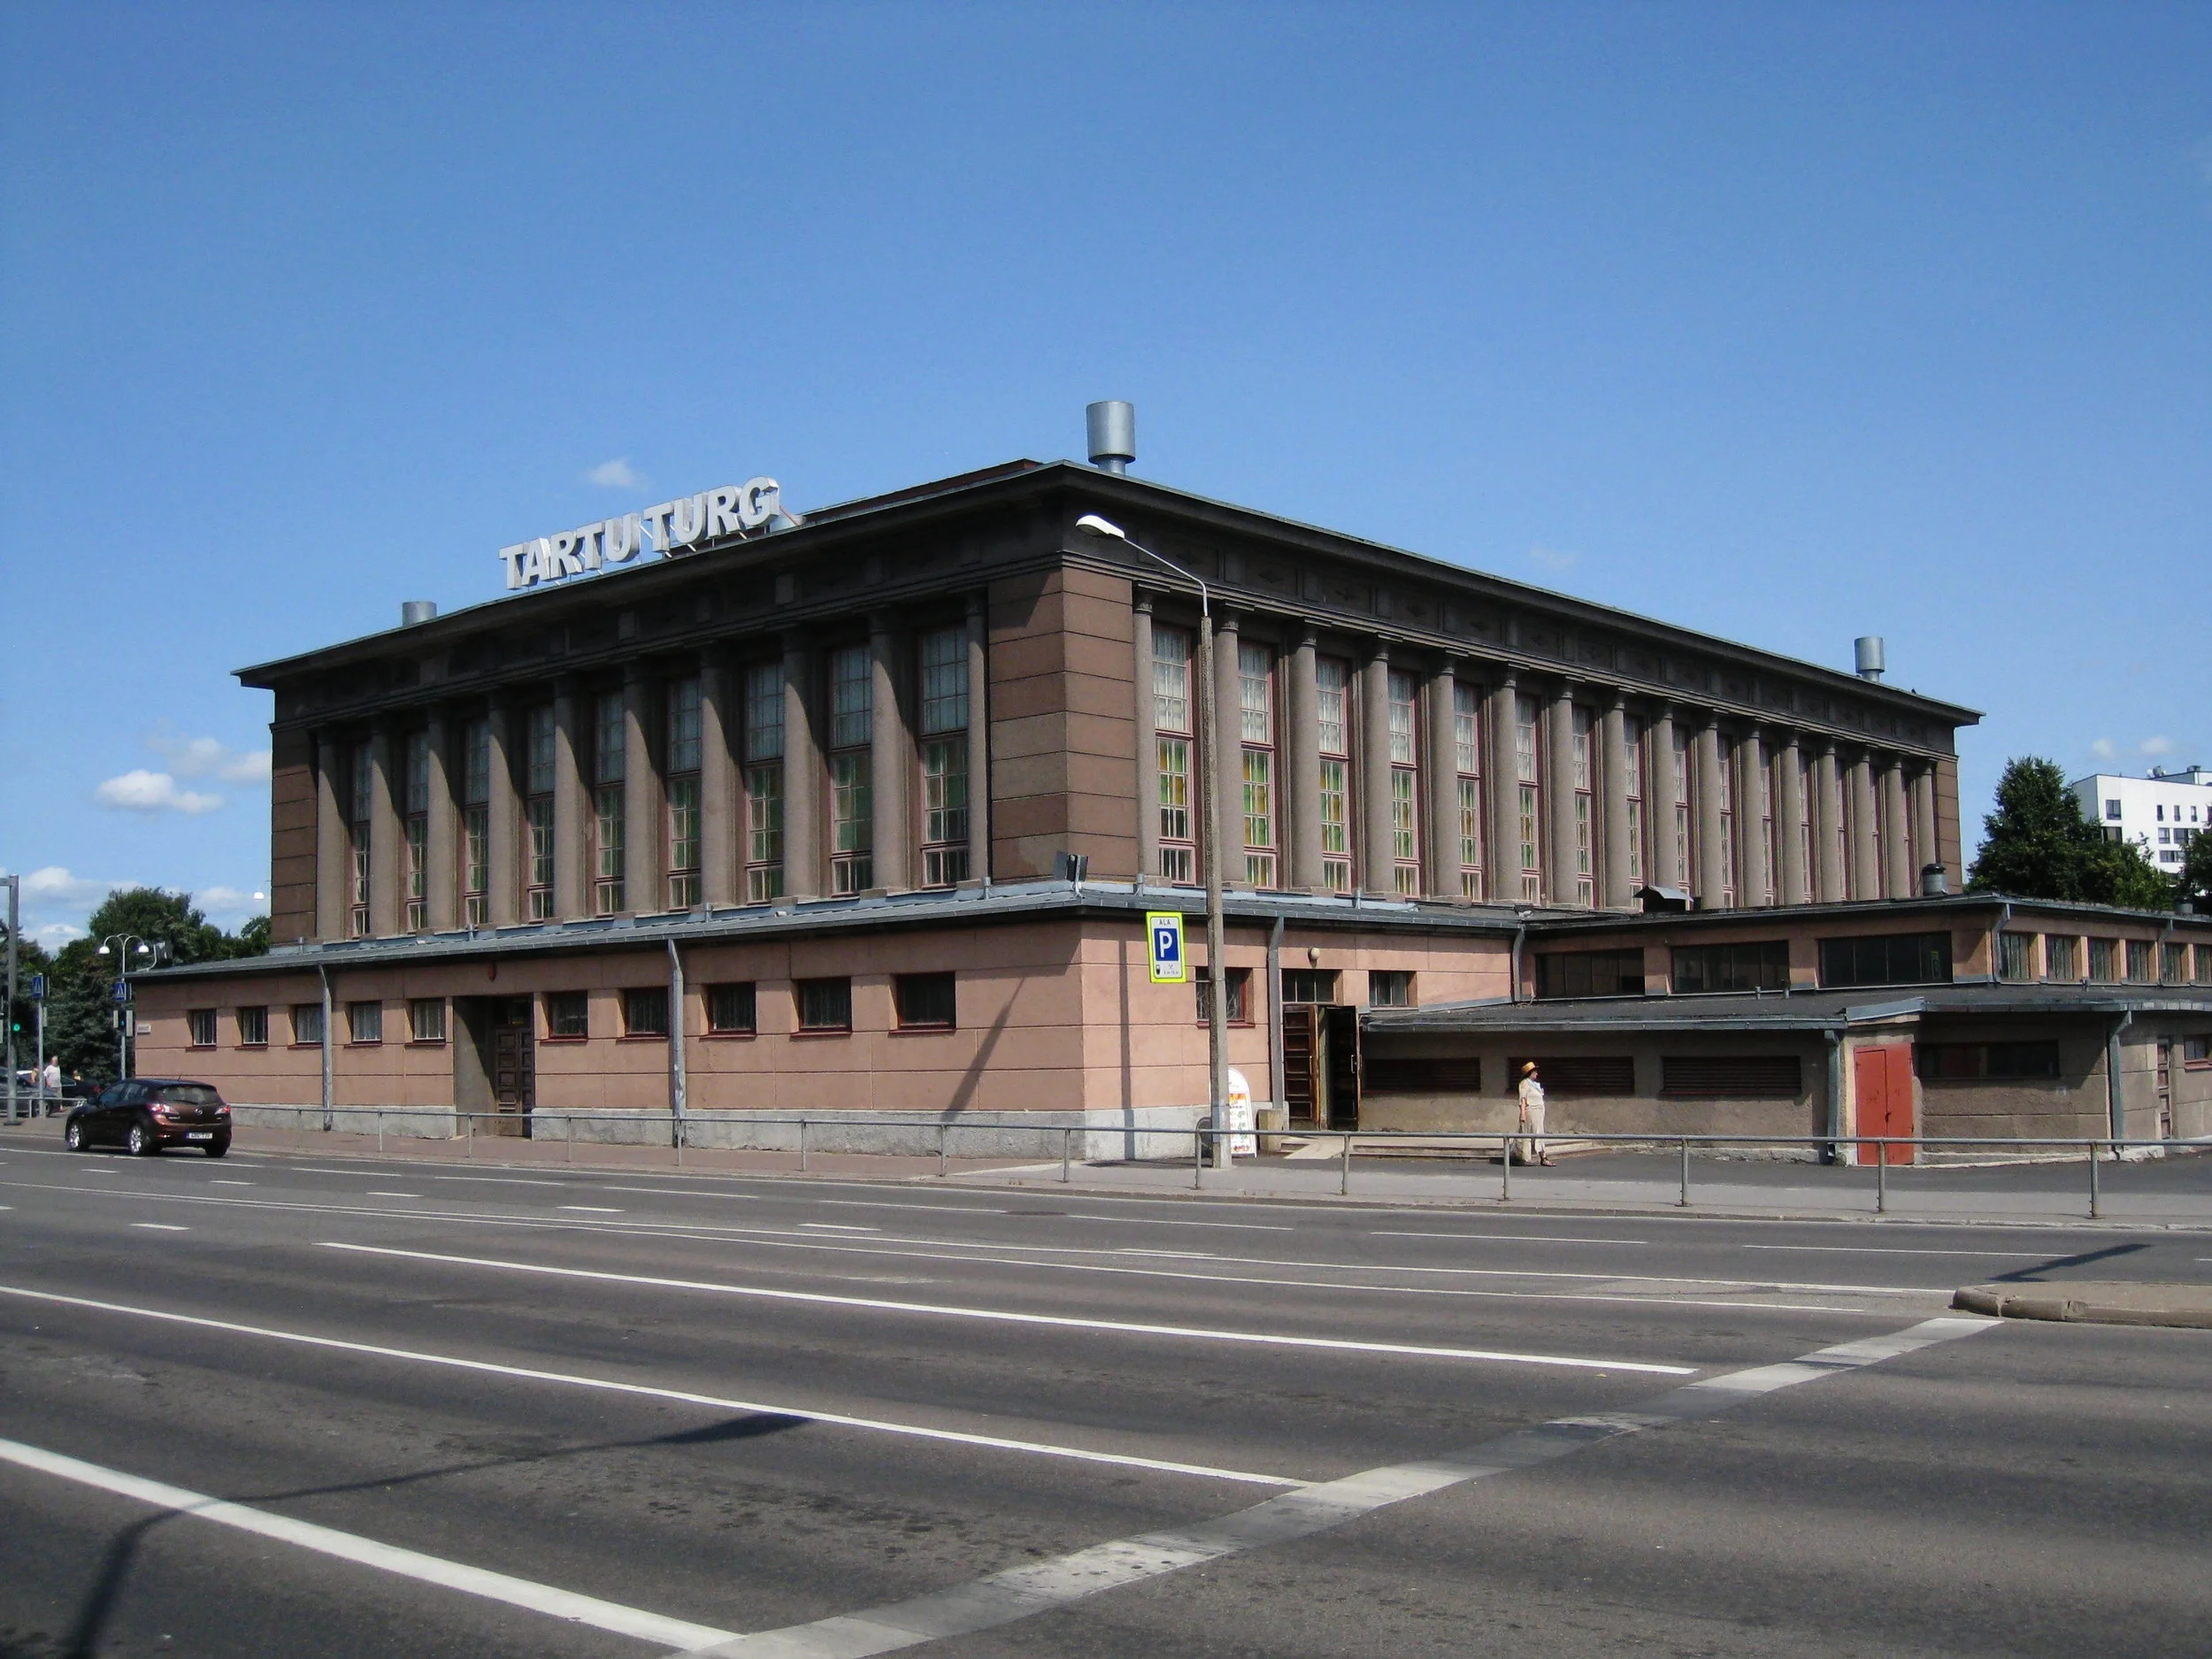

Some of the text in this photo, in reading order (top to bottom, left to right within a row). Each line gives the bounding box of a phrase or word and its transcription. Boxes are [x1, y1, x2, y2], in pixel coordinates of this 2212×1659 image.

[499, 476, 780, 590] TARTU TURG
[1159, 931, 1173, 958] P
